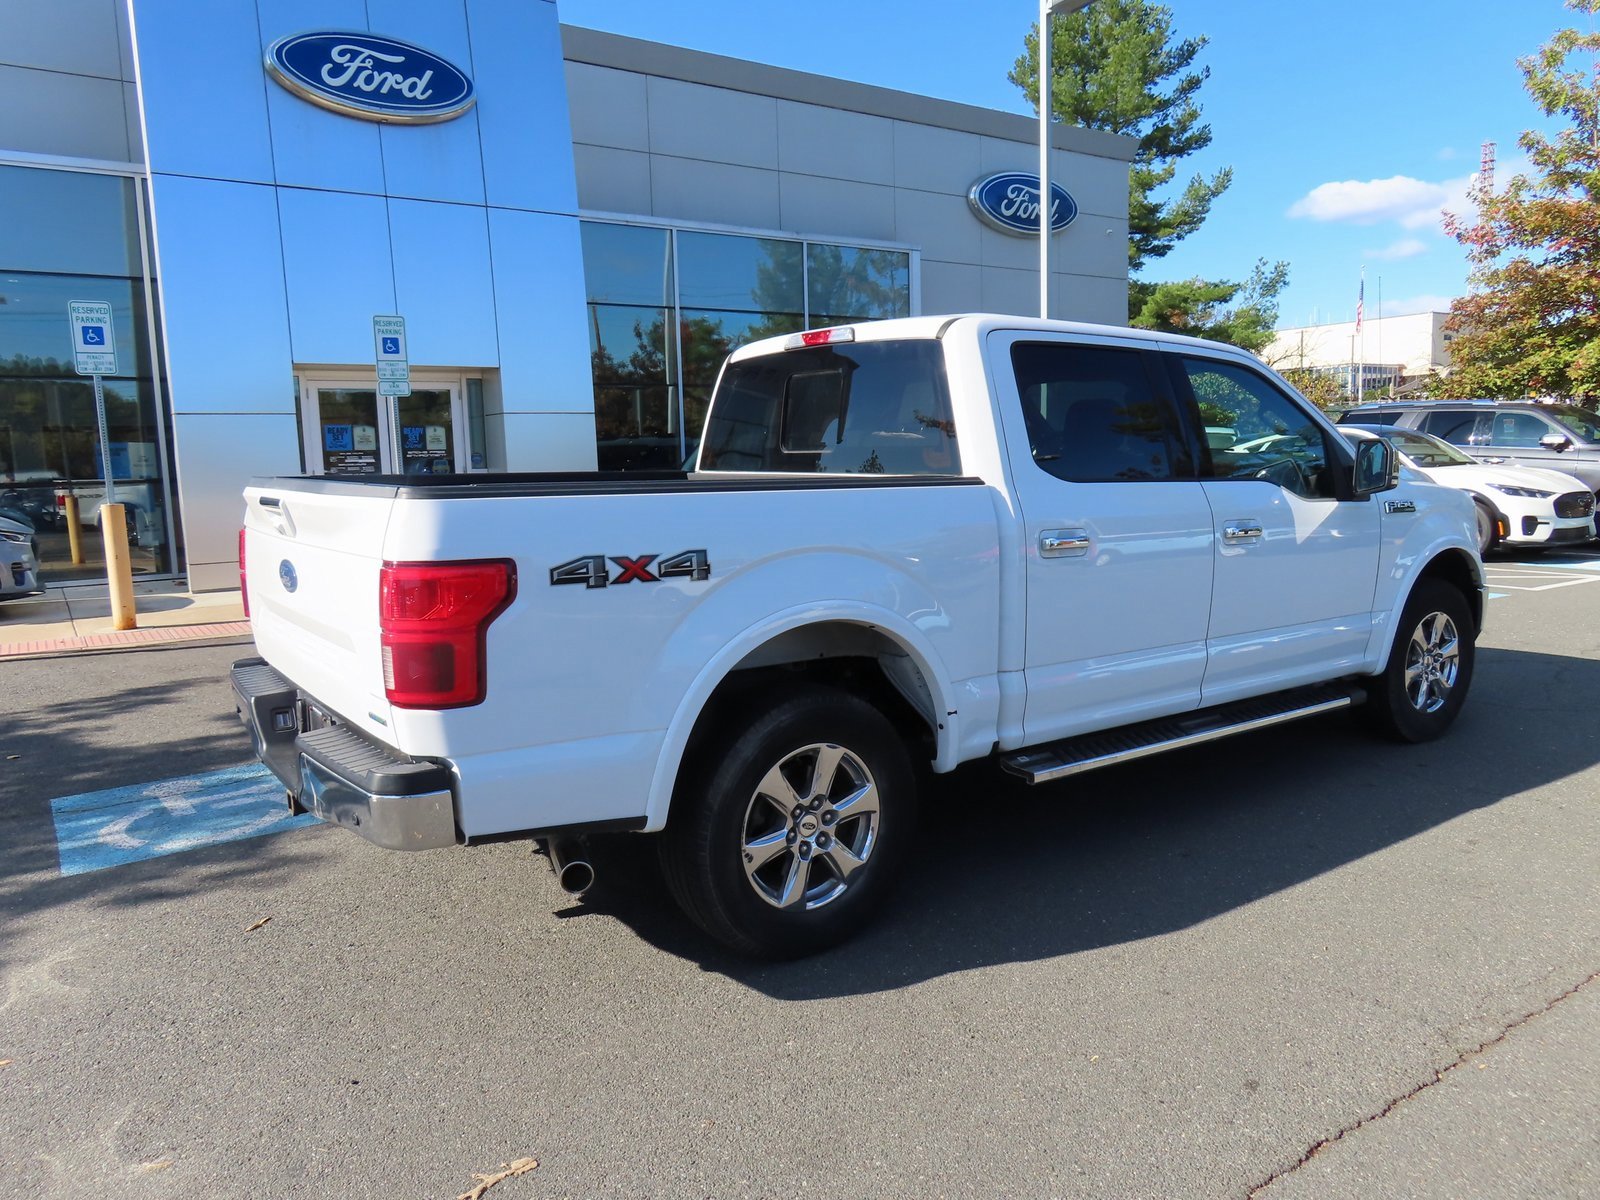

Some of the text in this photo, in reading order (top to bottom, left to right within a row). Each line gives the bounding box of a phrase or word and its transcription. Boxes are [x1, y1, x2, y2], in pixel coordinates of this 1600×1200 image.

[320, 44, 434, 100] Ford
[72, 306, 109, 315] RESERVED
[75, 316, 107, 324] PARKING
